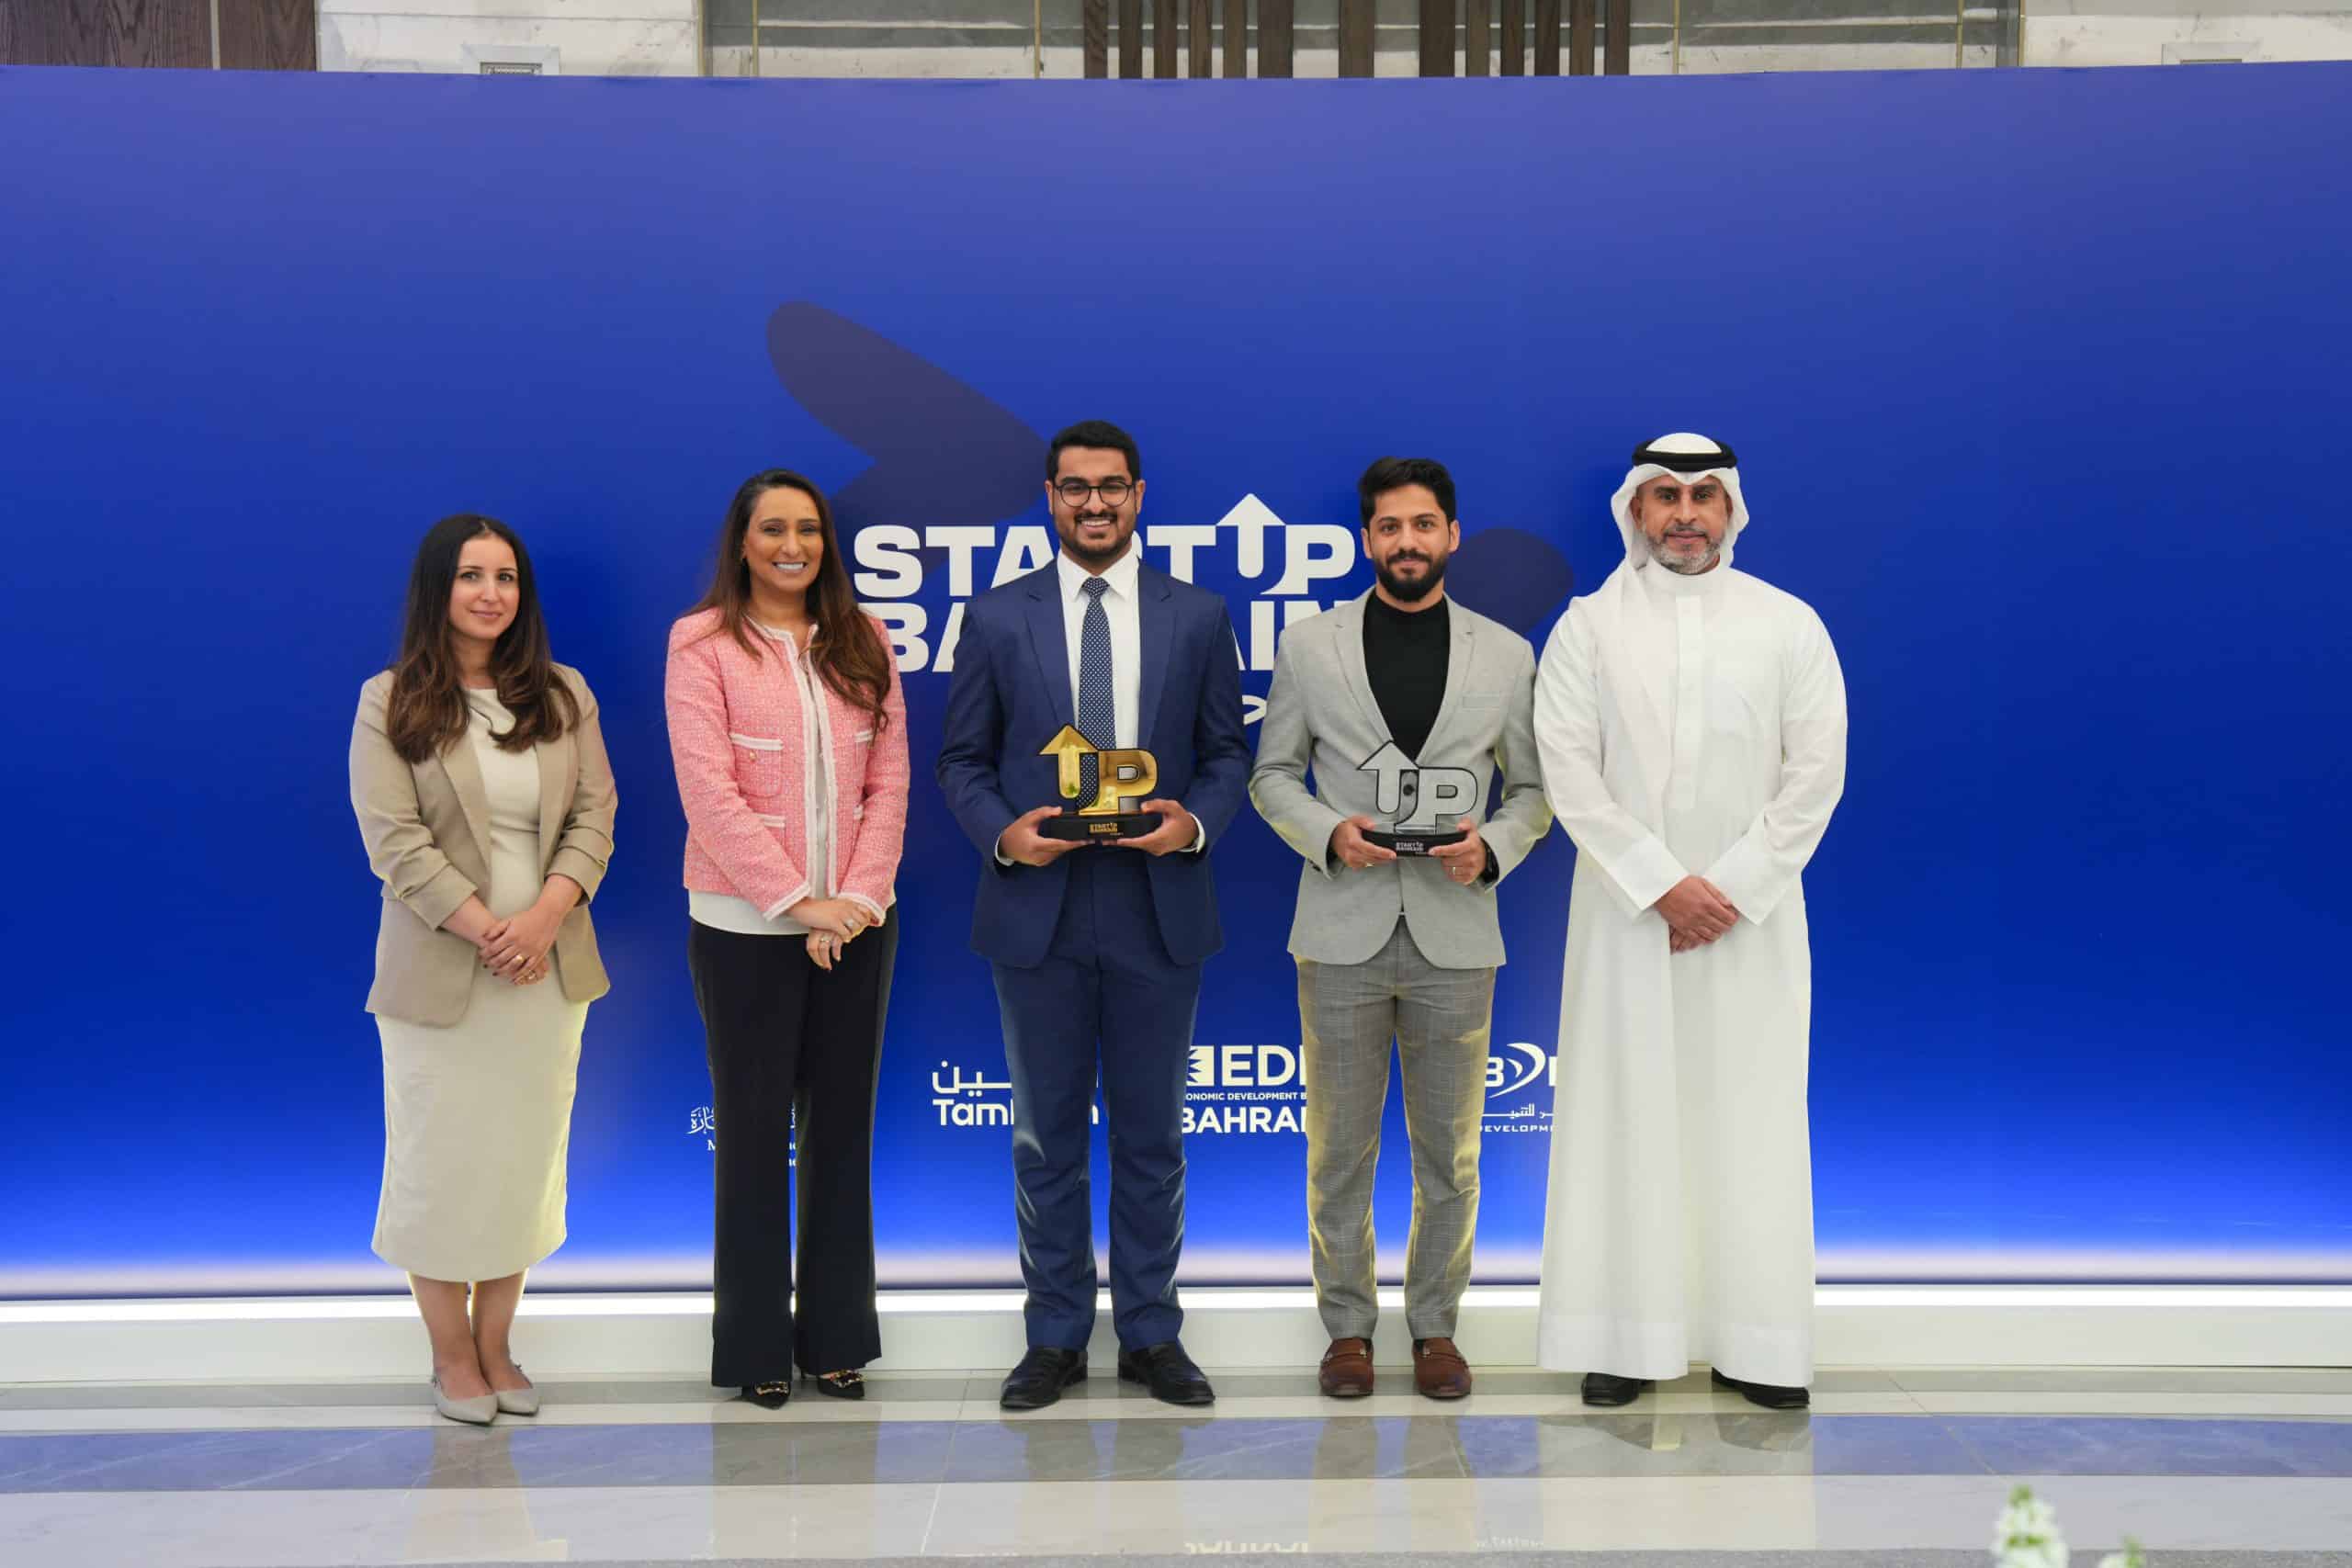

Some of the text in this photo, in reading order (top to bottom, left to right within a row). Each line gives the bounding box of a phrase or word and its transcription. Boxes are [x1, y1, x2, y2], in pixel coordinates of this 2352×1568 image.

[854, 493, 1355, 597] STATUP
[1185, 1092, 1225, 1100] ONOMIC
[1227, 1092, 1296, 1100] DEVELOPMENT
